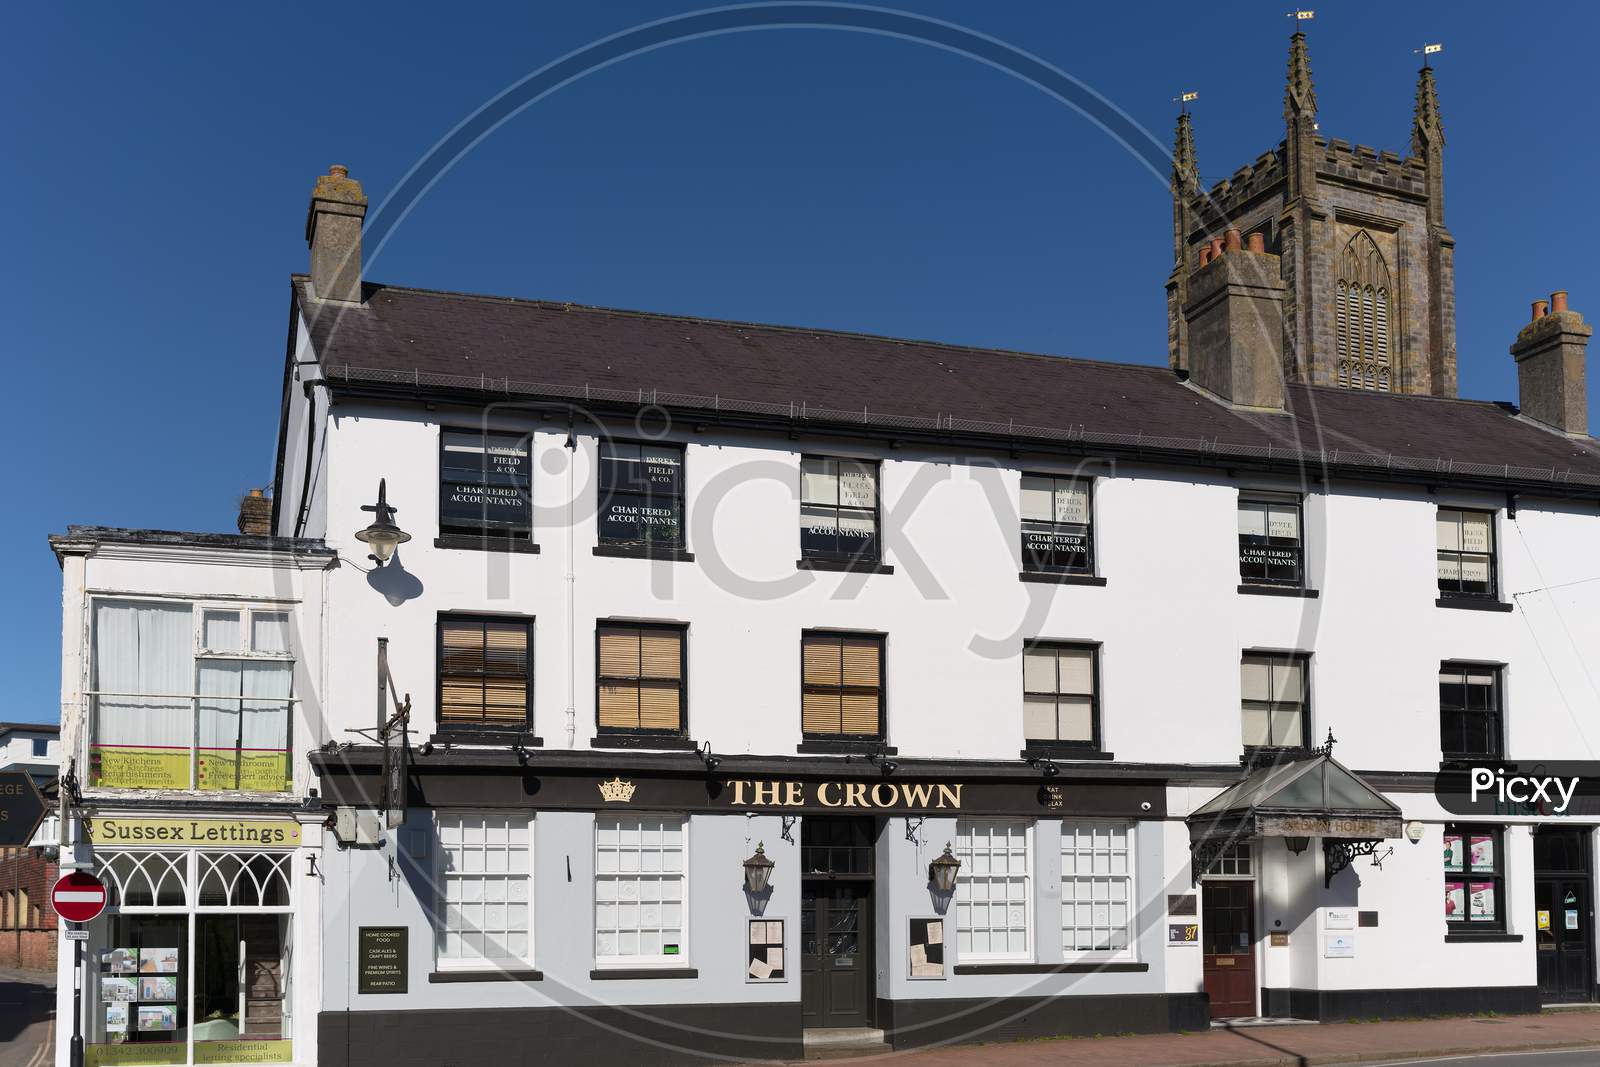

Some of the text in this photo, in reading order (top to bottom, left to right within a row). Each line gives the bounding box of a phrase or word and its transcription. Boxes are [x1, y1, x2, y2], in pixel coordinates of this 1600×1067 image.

[493, 457, 520, 465] FIELD
[648, 466, 674, 475] FIELD
[456, 485, 517, 497] CHARTERED
[450, 494, 522, 506] ACCOUNTANTS
[611, 505, 671, 517] CHARTERED
[607, 514, 677, 526] ACCOUNTANTS
[808, 527, 870, 538] ACCOUNTANTS
[1029, 534, 1081, 545] CHARTERED
[1025, 543, 1086, 553] ACCOUNTANTS
[1243, 548, 1292, 558] CHARTERED
[1239, 556, 1297, 567] ACCOUNTANTS
[208, 759, 226, 767] New
[727, 780, 964, 809] THE CROWN
[101, 820, 285, 844] Sussex Lettings
[1335, 821, 1377, 833] HOUSE
[217, 1043, 268, 1052] Residential
[234, 1052, 282, 1063] specialists
